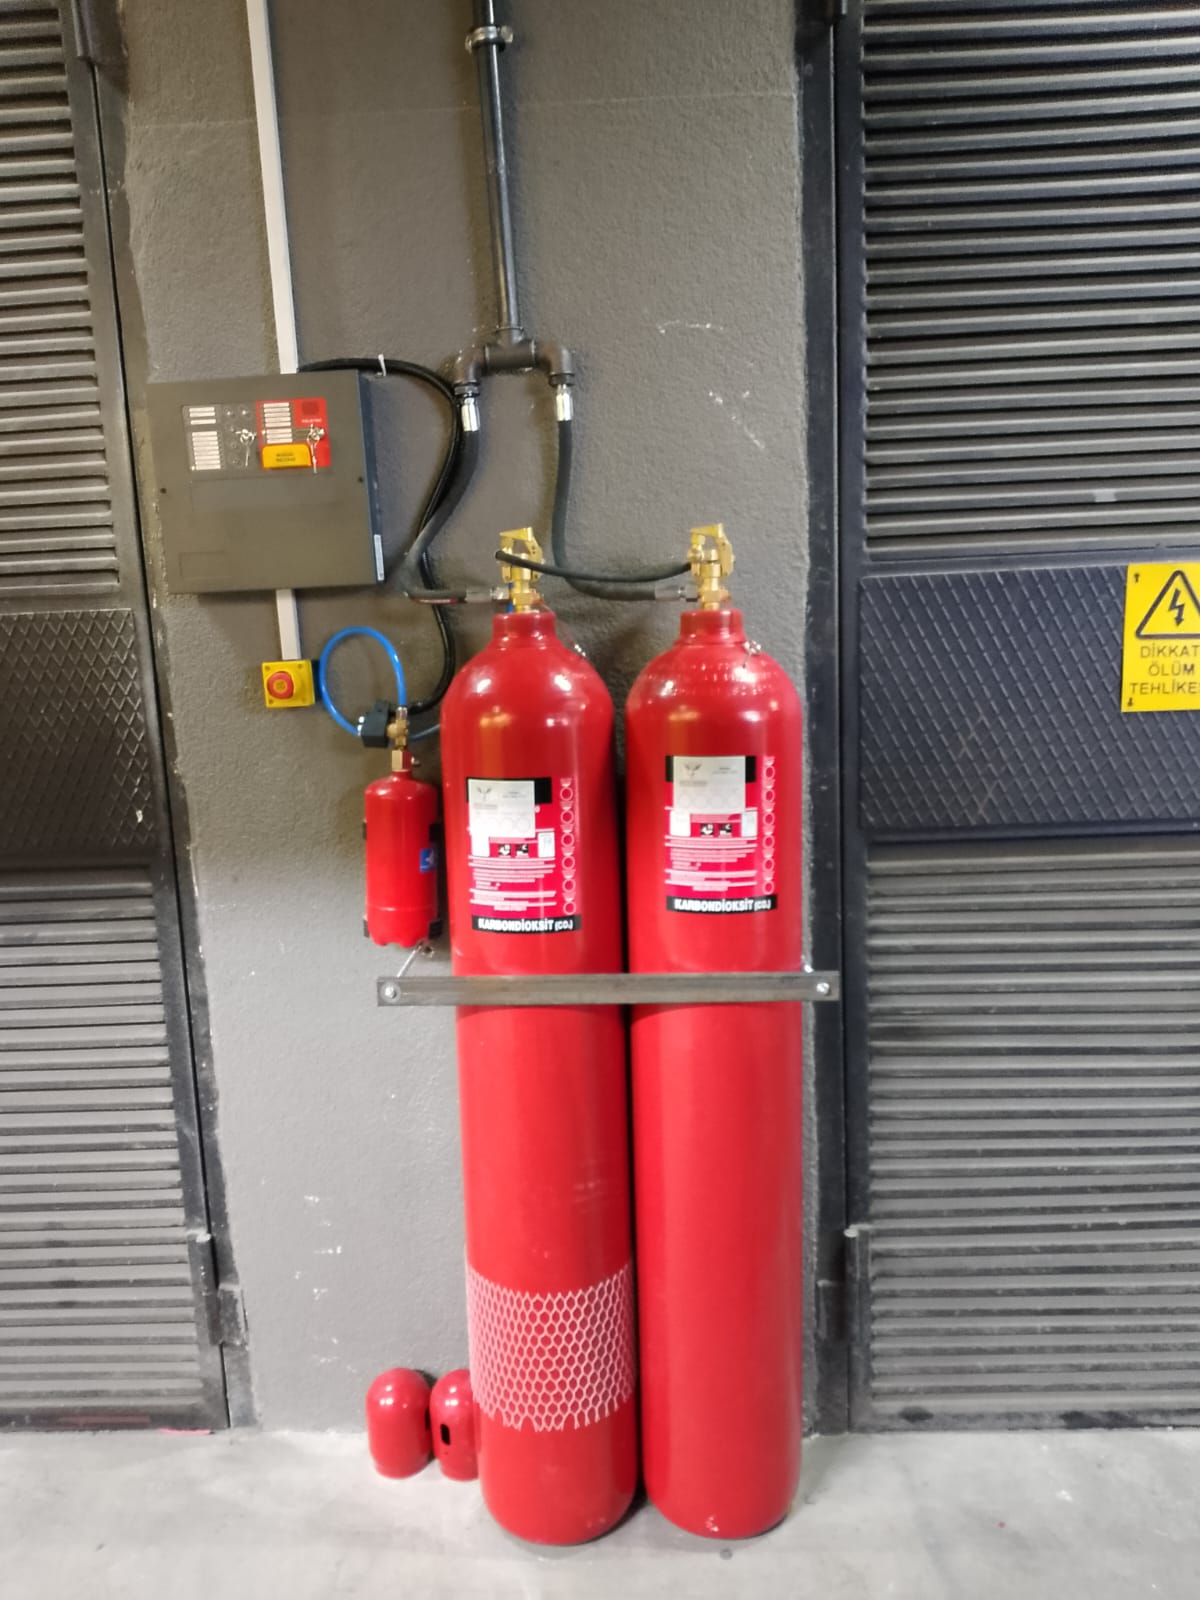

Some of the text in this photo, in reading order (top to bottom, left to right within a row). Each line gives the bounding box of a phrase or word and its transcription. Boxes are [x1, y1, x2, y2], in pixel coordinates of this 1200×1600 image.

[1140, 643, 1200, 658] DİKKAT
[1149, 660, 1195, 677] ÖLÜM
[1130, 679, 1200, 695] TEHLİKE
[673, 897, 754, 912] KARBONDİOKSİT
[477, 918, 554, 932] KARBONDİOKSİT
